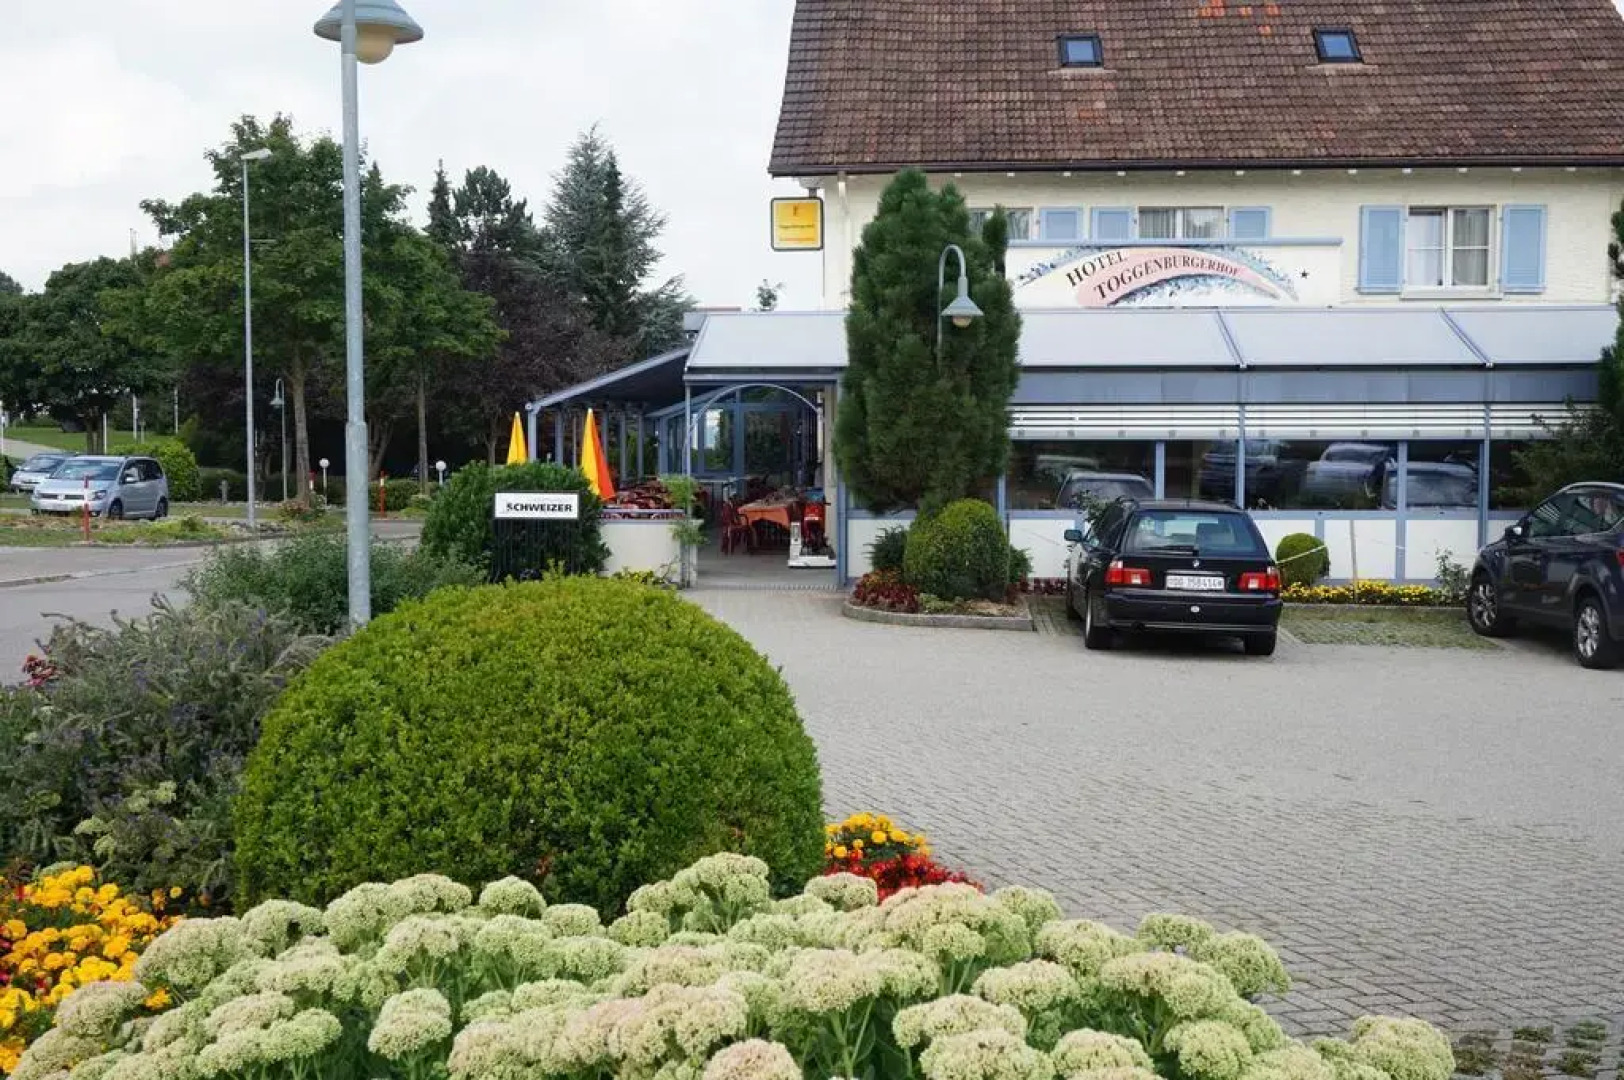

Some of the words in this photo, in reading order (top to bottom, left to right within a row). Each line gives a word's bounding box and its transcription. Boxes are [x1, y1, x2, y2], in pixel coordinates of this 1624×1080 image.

[1065, 251, 1128, 286] HOTEL
[1093, 255, 1238, 298] TOGGENBURGERHOF
[506, 503, 572, 512] SCHWEIZER
